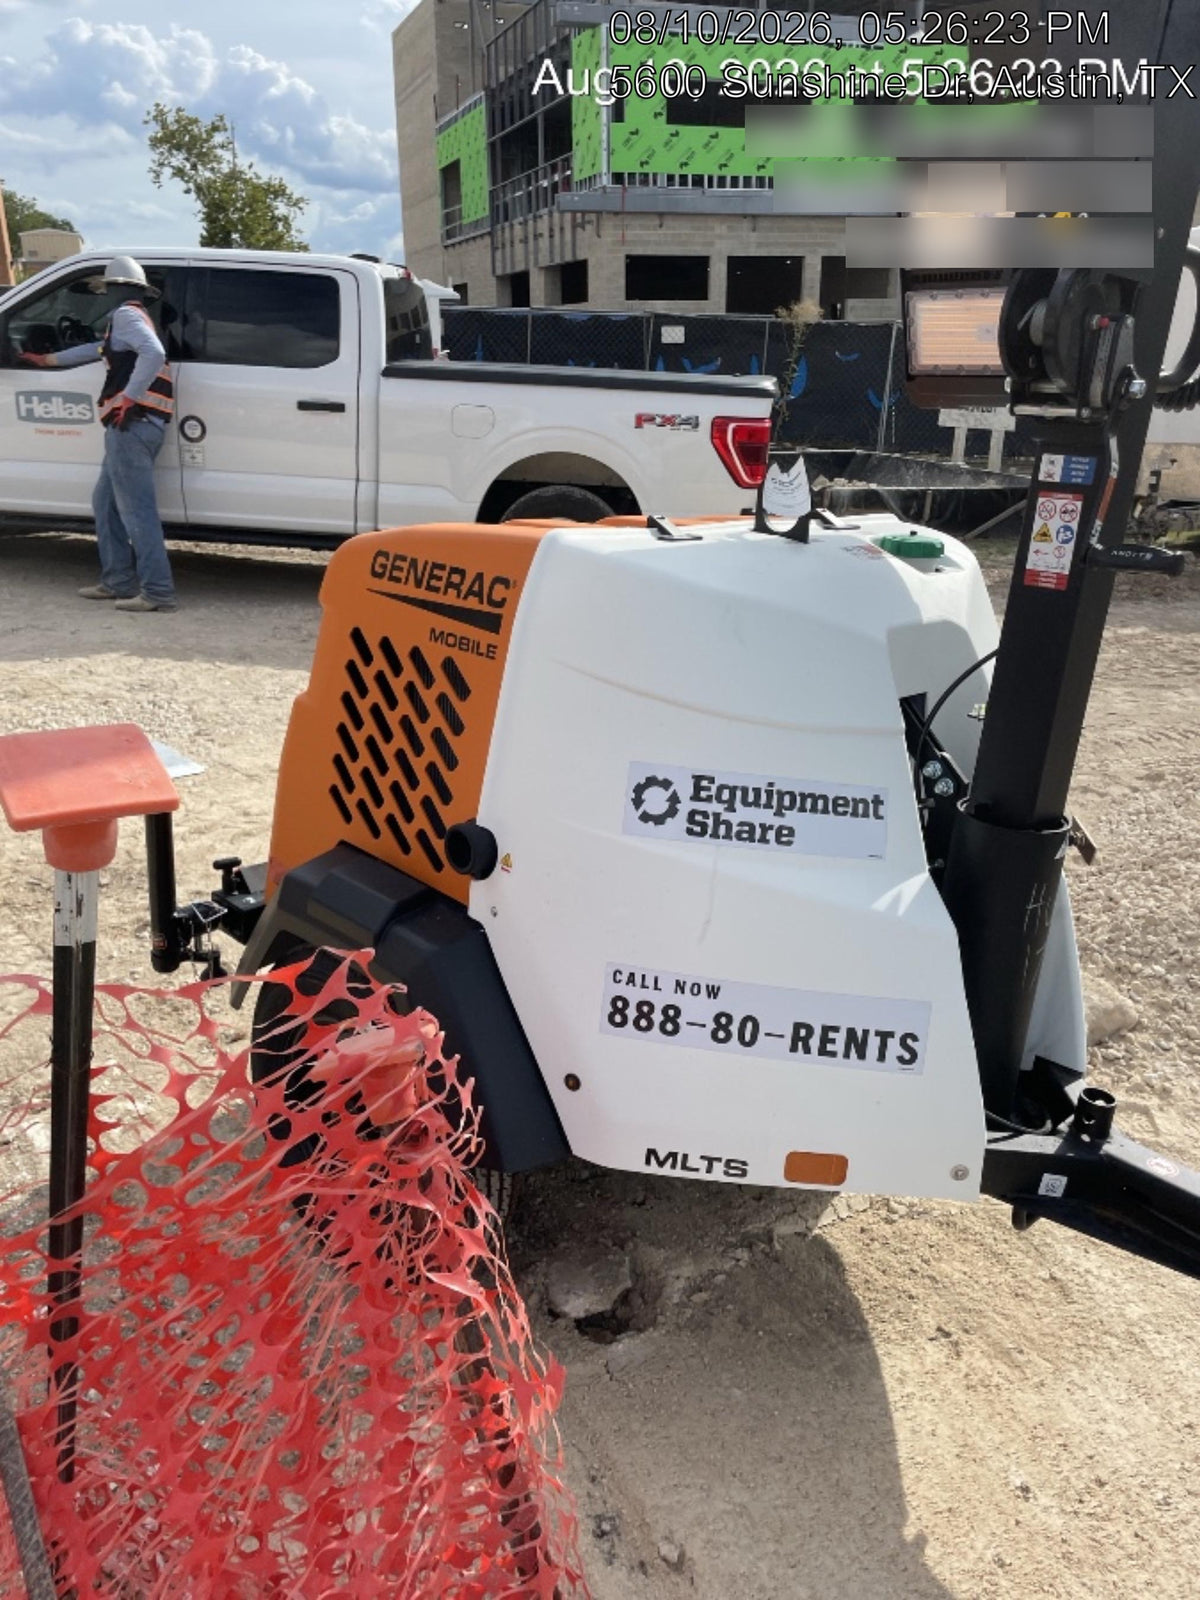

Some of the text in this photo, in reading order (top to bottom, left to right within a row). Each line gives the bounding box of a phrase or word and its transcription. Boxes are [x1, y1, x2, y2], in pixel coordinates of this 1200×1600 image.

[18, 395, 92, 420] Hellas
[634, 412, 699, 430] FX4
[370, 549, 511, 609] GENERAC
[429, 627, 498, 660] MOBILE
[689, 774, 885, 821] Equipment
[685, 808, 795, 847] Share
[612, 968, 722, 1000] CALL NOW
[644, 1147, 749, 1178] MLTS
